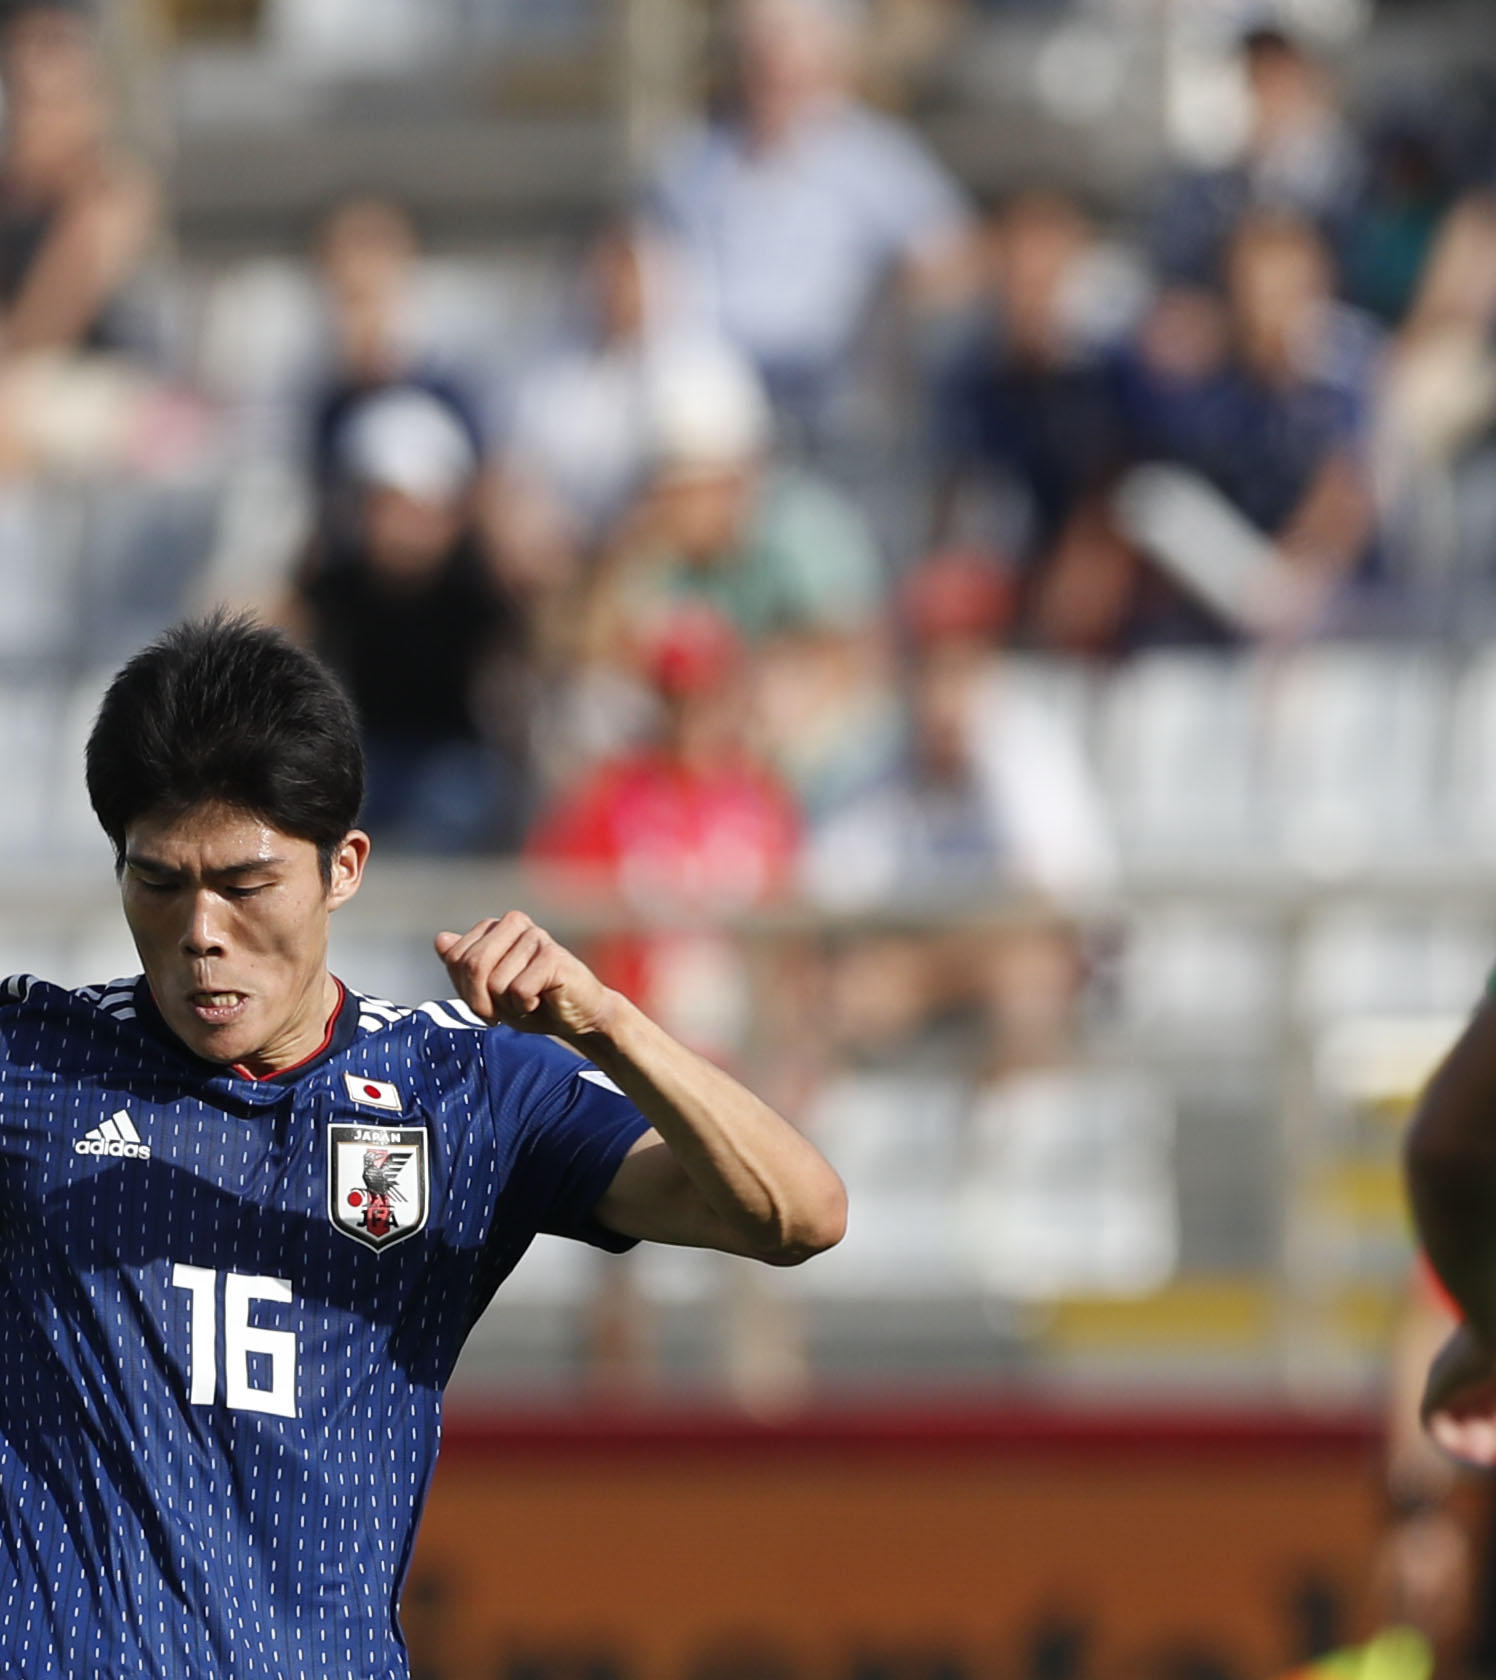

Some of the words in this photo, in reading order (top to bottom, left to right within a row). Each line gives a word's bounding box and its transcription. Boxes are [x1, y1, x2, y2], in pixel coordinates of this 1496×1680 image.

[353, 1129, 401, 1143] JAPAN
[75, 1137, 151, 1160] adidas
[356, 1209, 400, 1228] JFA
[172, 1263, 296, 1418] 16
